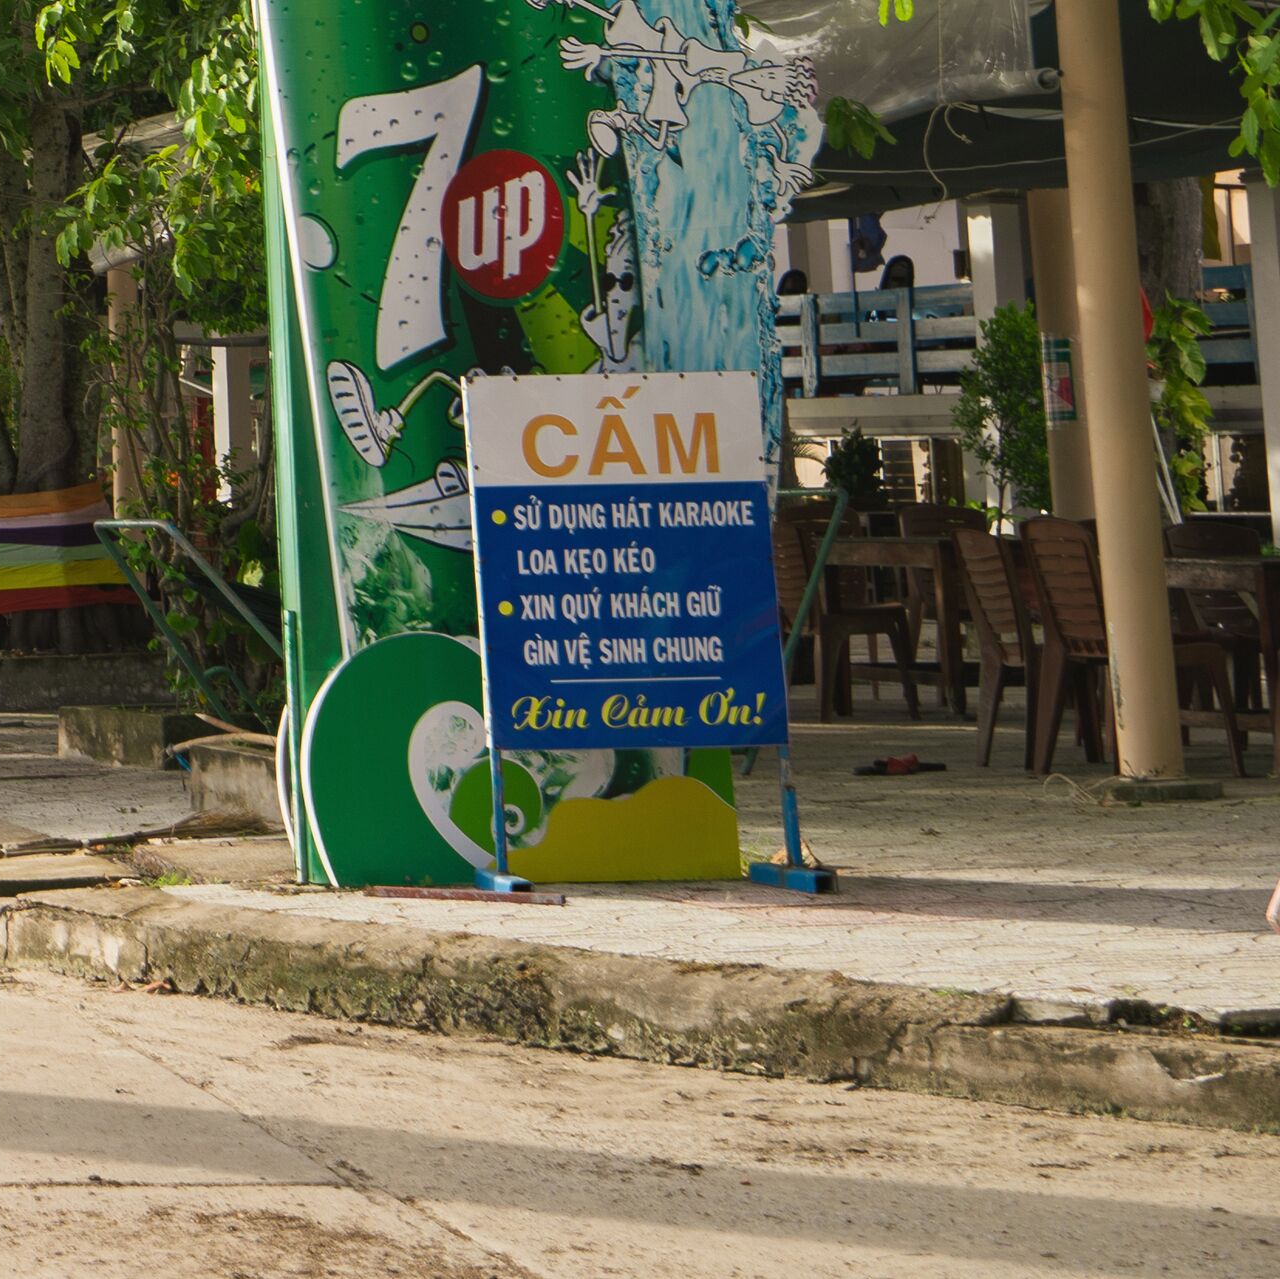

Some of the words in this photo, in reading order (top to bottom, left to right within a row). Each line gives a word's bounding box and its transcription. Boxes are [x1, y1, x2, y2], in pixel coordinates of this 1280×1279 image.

[522, 386, 721, 478] CẤM
[513, 495, 541, 531] SỬ
[548, 503, 606, 535] DỤNG
[612, 496, 652, 528] HÁT
[659, 501, 755, 528] KARAOKE
[517, 549, 558, 576] LOA
[564, 548, 607, 579] KẸO
[613, 540, 656, 572] KÉO
[520, 594, 555, 620] XIN
[561, 586, 602, 624] QUÝ
[610, 586, 680, 619] KHÁCH
[686, 585, 723, 618] GIỮ
[523, 633, 560, 666] GÌN
[564, 633, 591, 669] VỆ
[599, 639, 646, 664] SINH
[653, 635, 724, 663] CHUNG
[511, 695, 590, 731] Xin
[600, 693, 688, 729] Cảm
[698, 686, 767, 726] Ơn!
